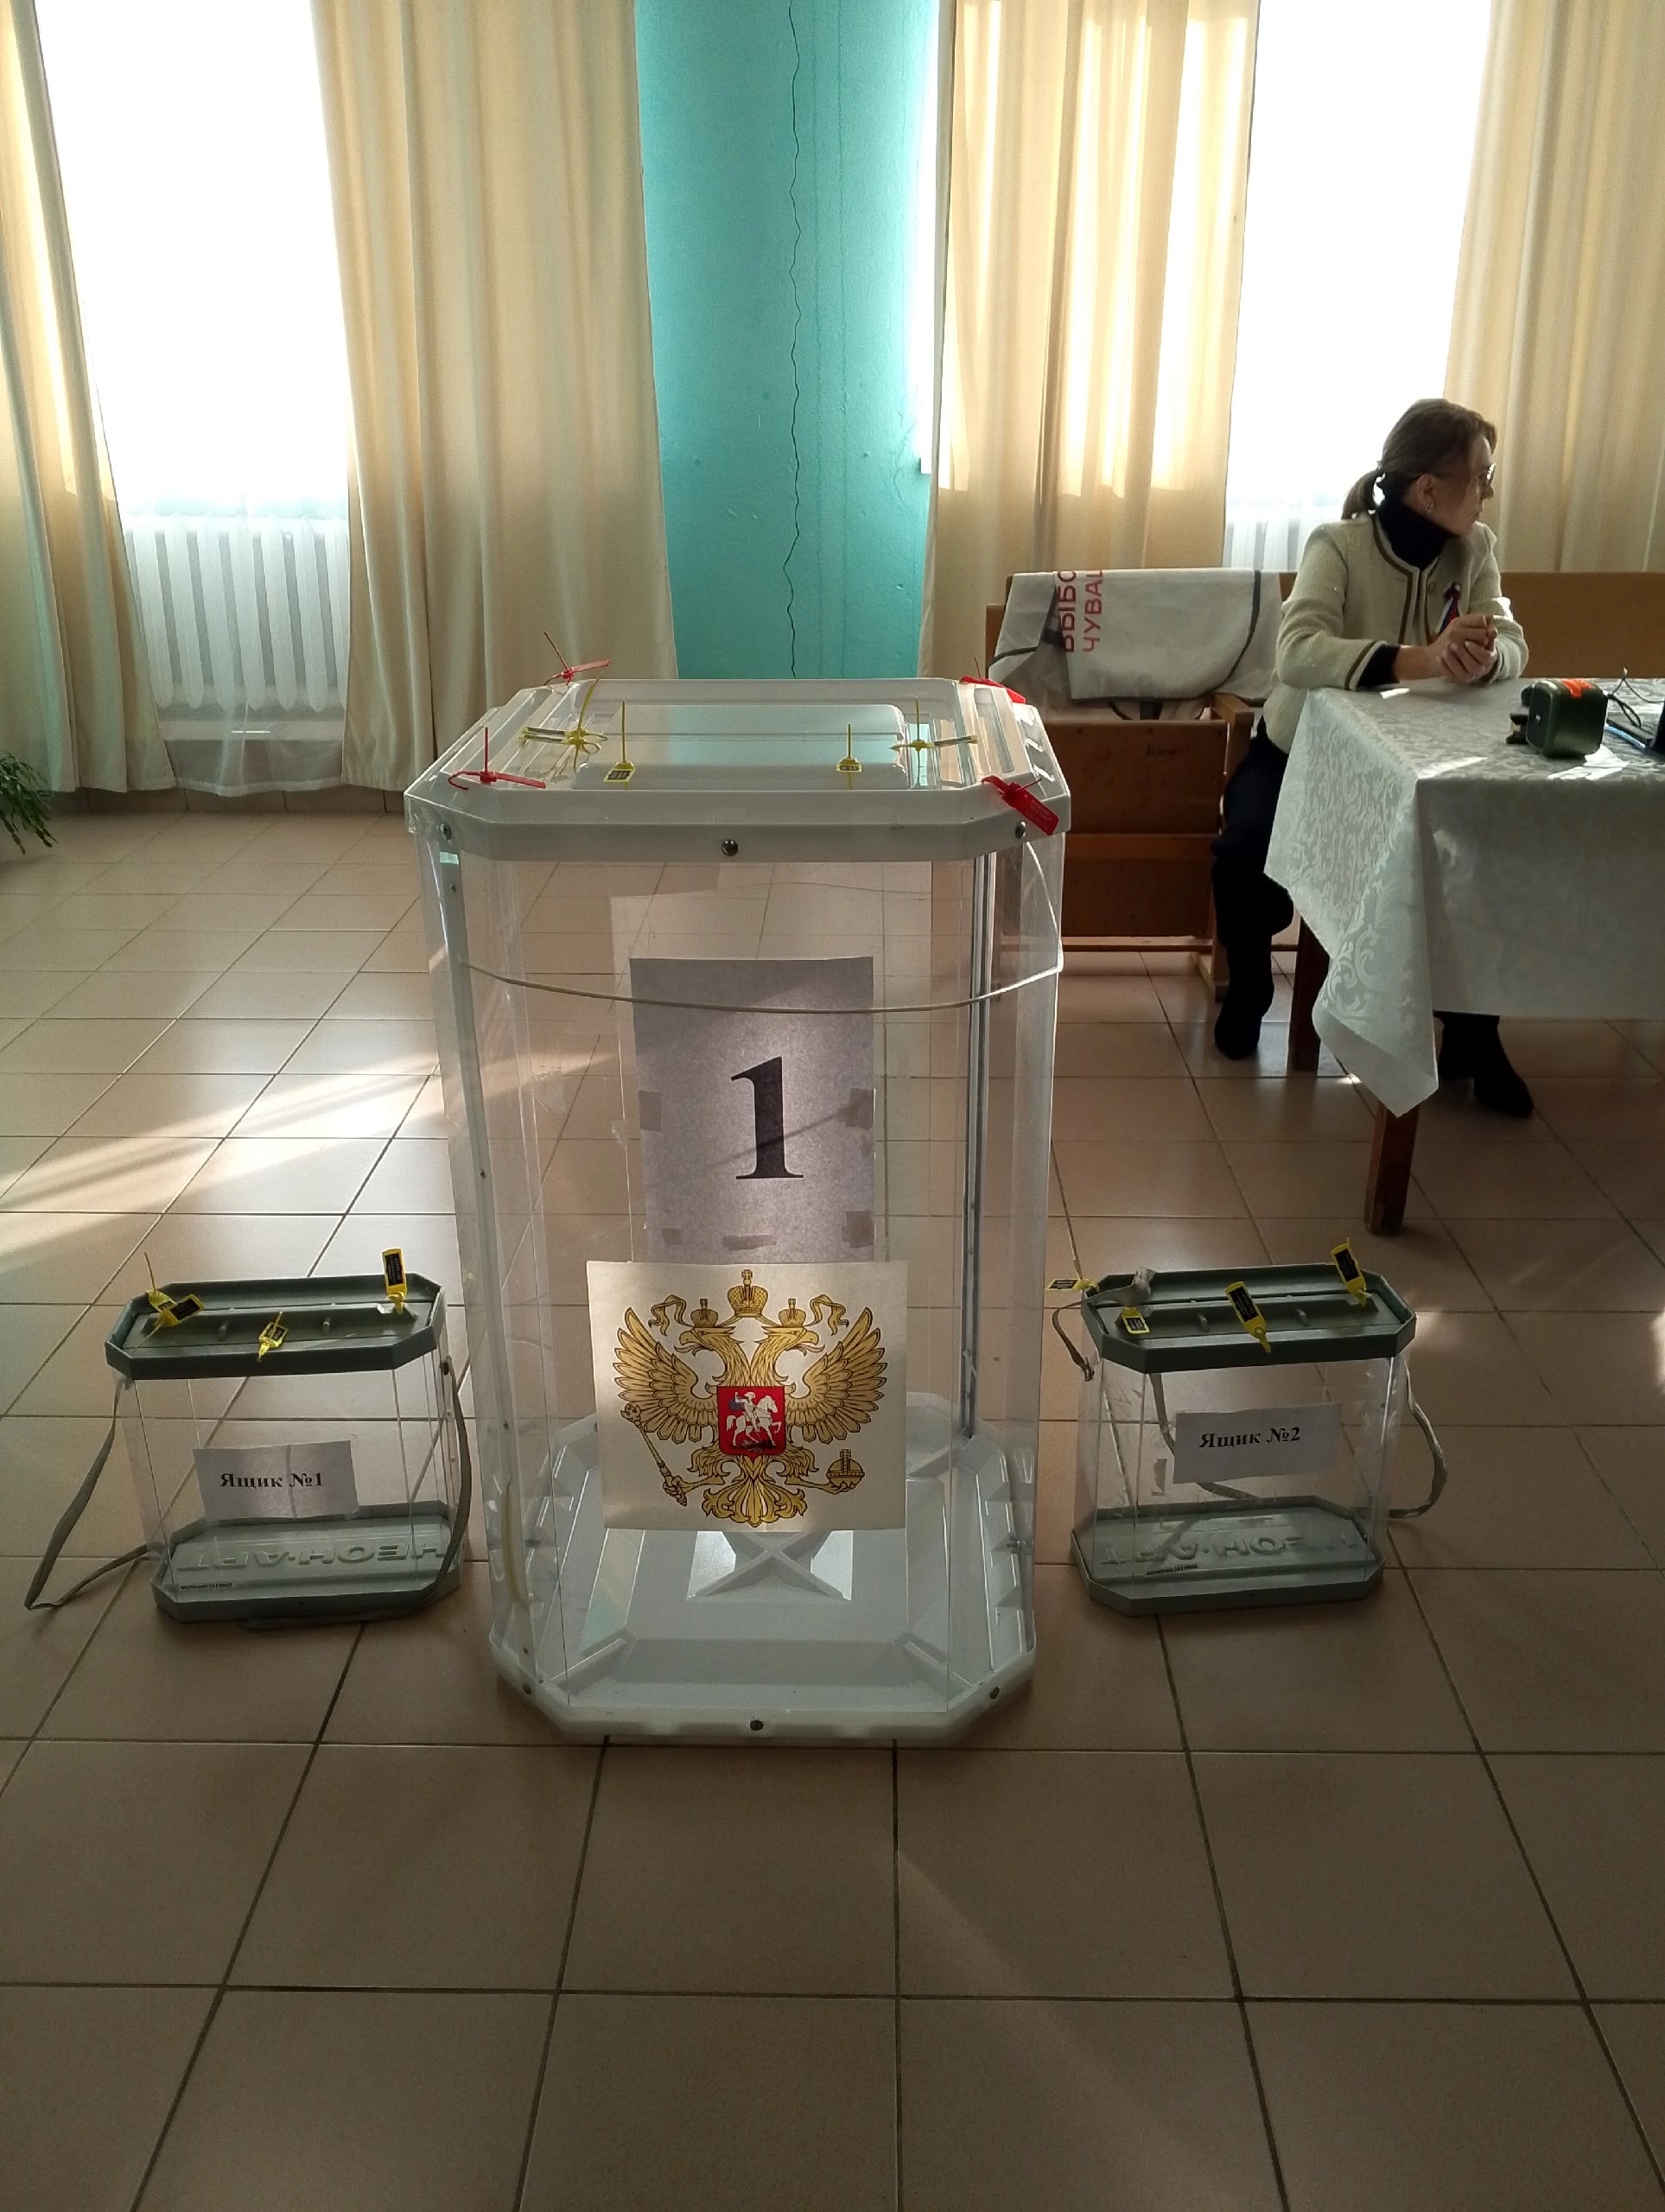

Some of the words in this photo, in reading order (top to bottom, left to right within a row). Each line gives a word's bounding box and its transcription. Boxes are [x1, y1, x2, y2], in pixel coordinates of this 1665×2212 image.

[730, 1056, 804, 1179] 1
[1199, 1433, 1261, 1448] Ящик
[1266, 1427, 1300, 1444] №2
[219, 1472, 283, 1491] Ящик
[289, 1472, 322, 1488] №1
